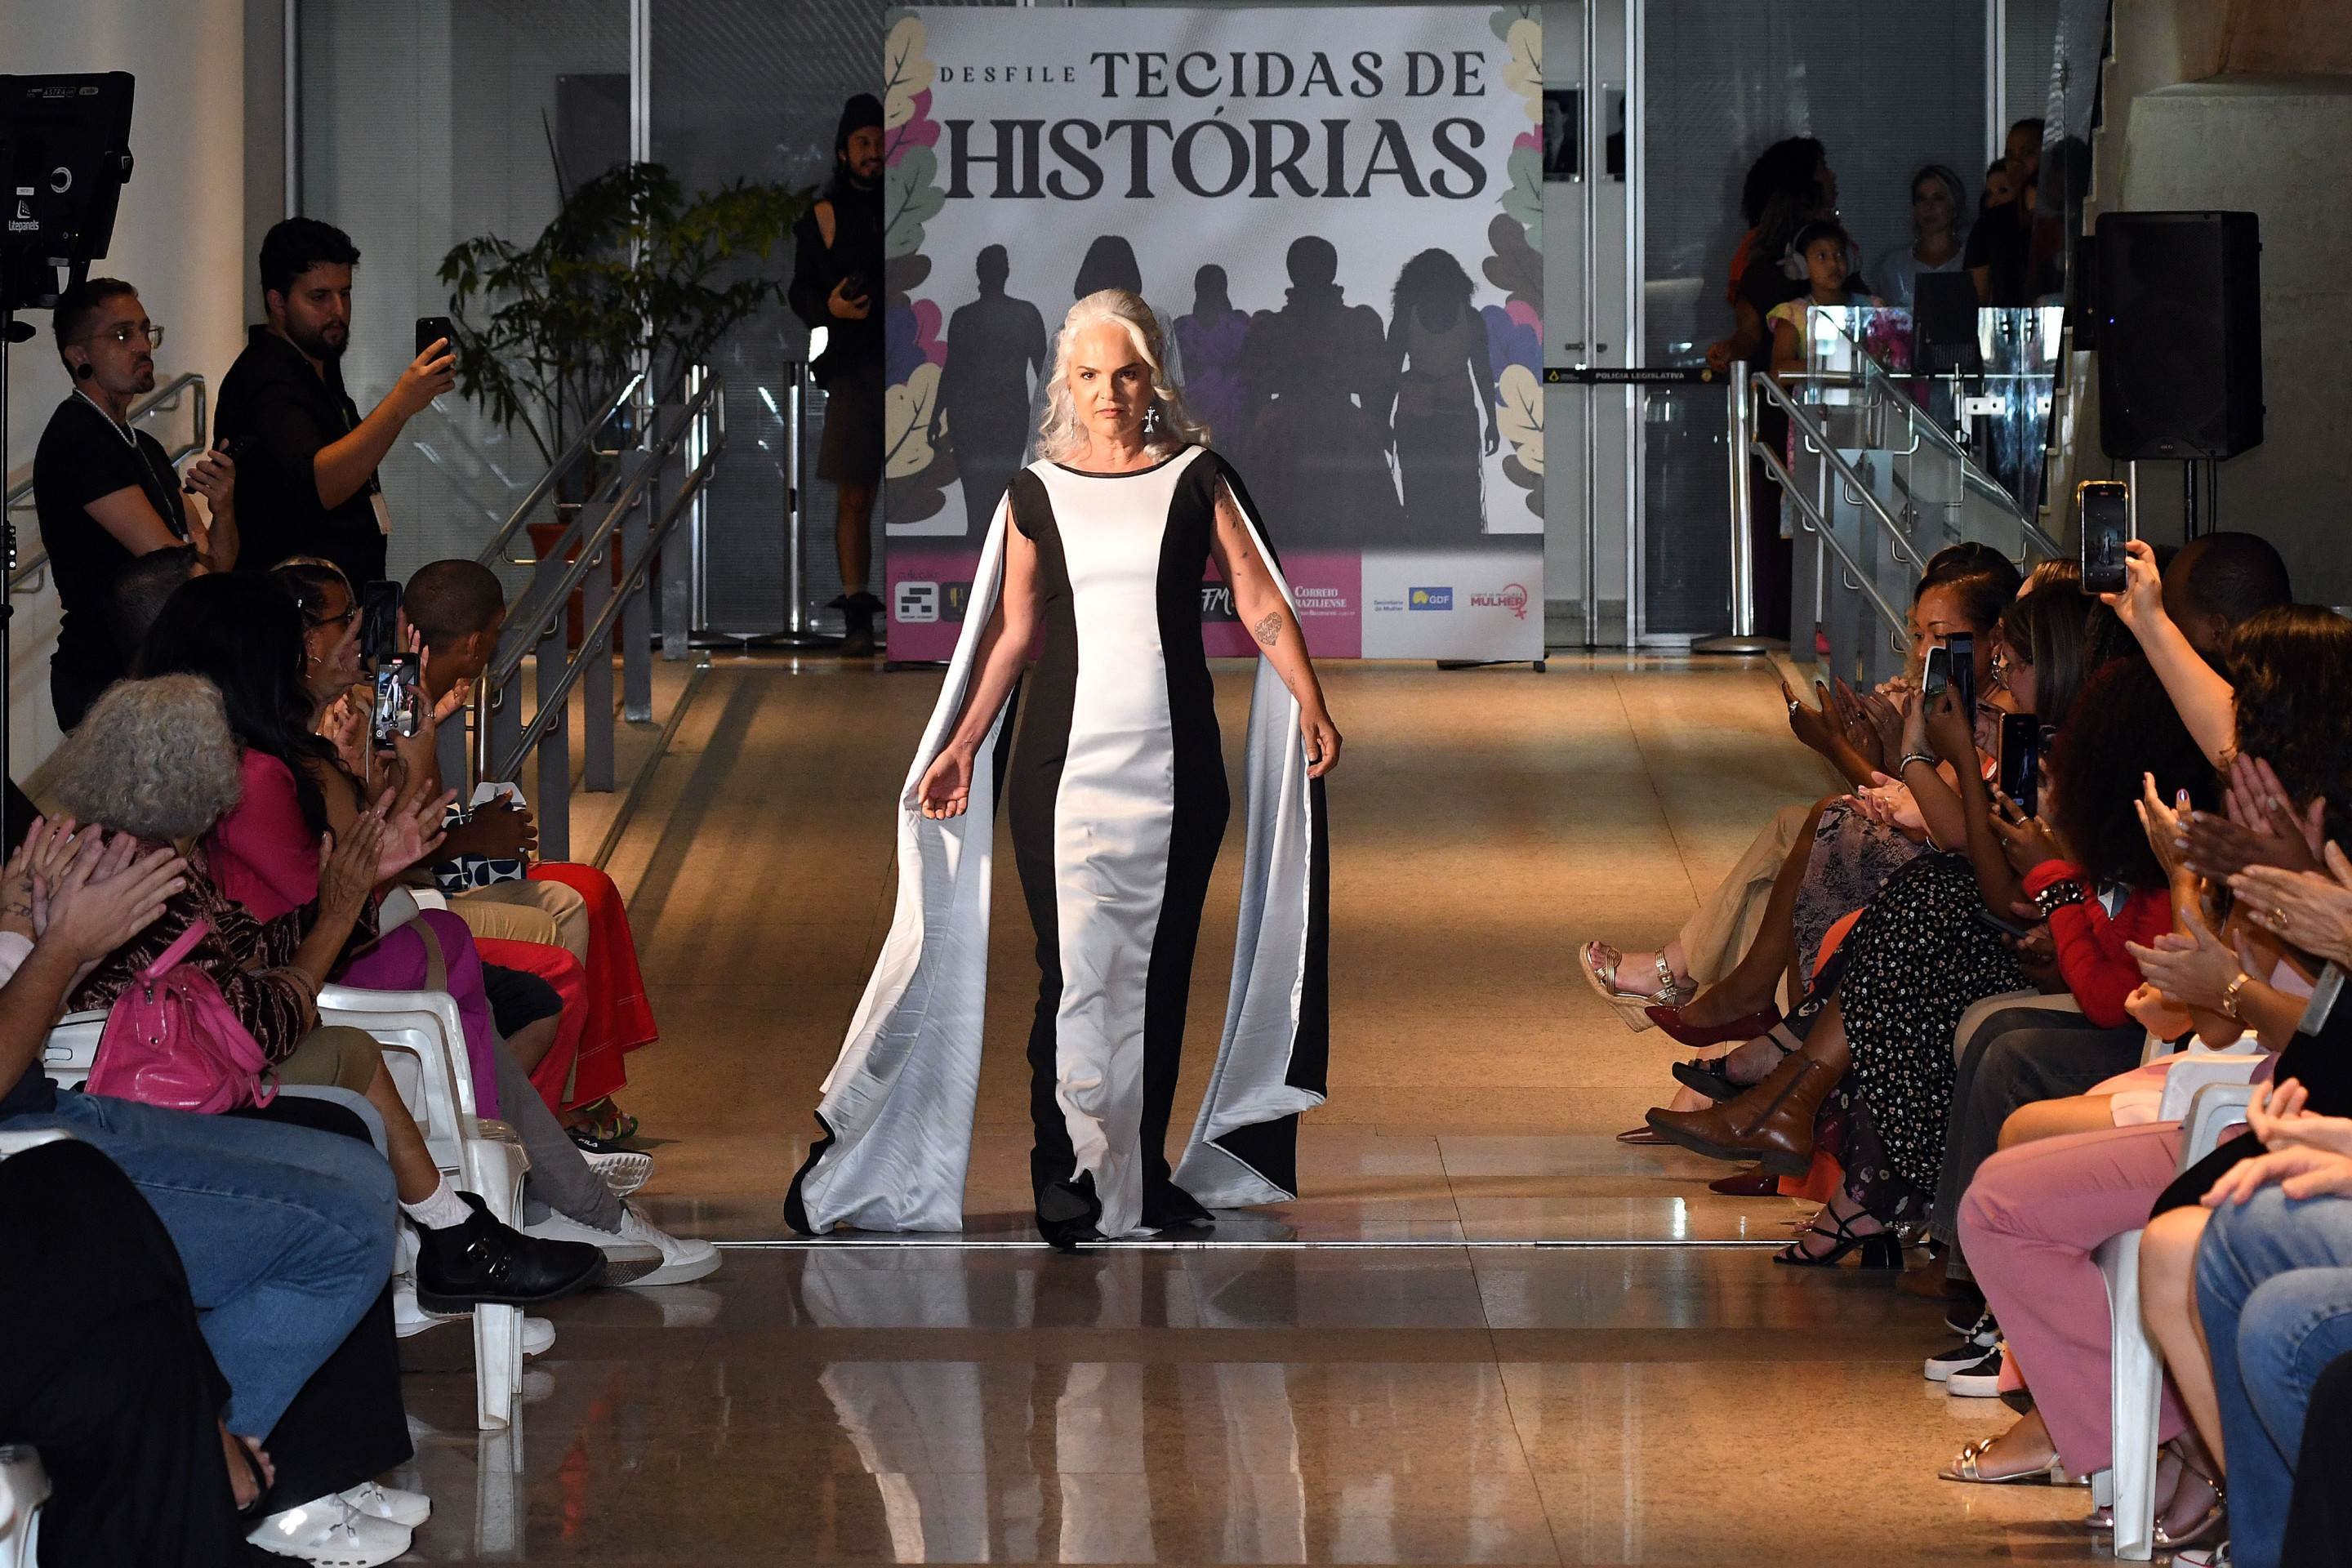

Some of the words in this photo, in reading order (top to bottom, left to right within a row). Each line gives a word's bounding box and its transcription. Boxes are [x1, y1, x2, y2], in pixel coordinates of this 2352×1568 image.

[940, 66, 1075, 83] DESFILE
[1089, 51, 1384, 99] TECIDAS
[1404, 51, 1486, 97] DE
[944, 105, 1487, 200] HISTÓRIAS
[8, 219, 39, 233] Litepanels
[1201, 586, 1232, 615] FM
[1294, 599, 1347, 608] RAZILIENSE
[1429, 595, 1450, 604] GDF
[1471, 597, 1523, 606] MULHER
[577, 1138, 599, 1147] FILA
